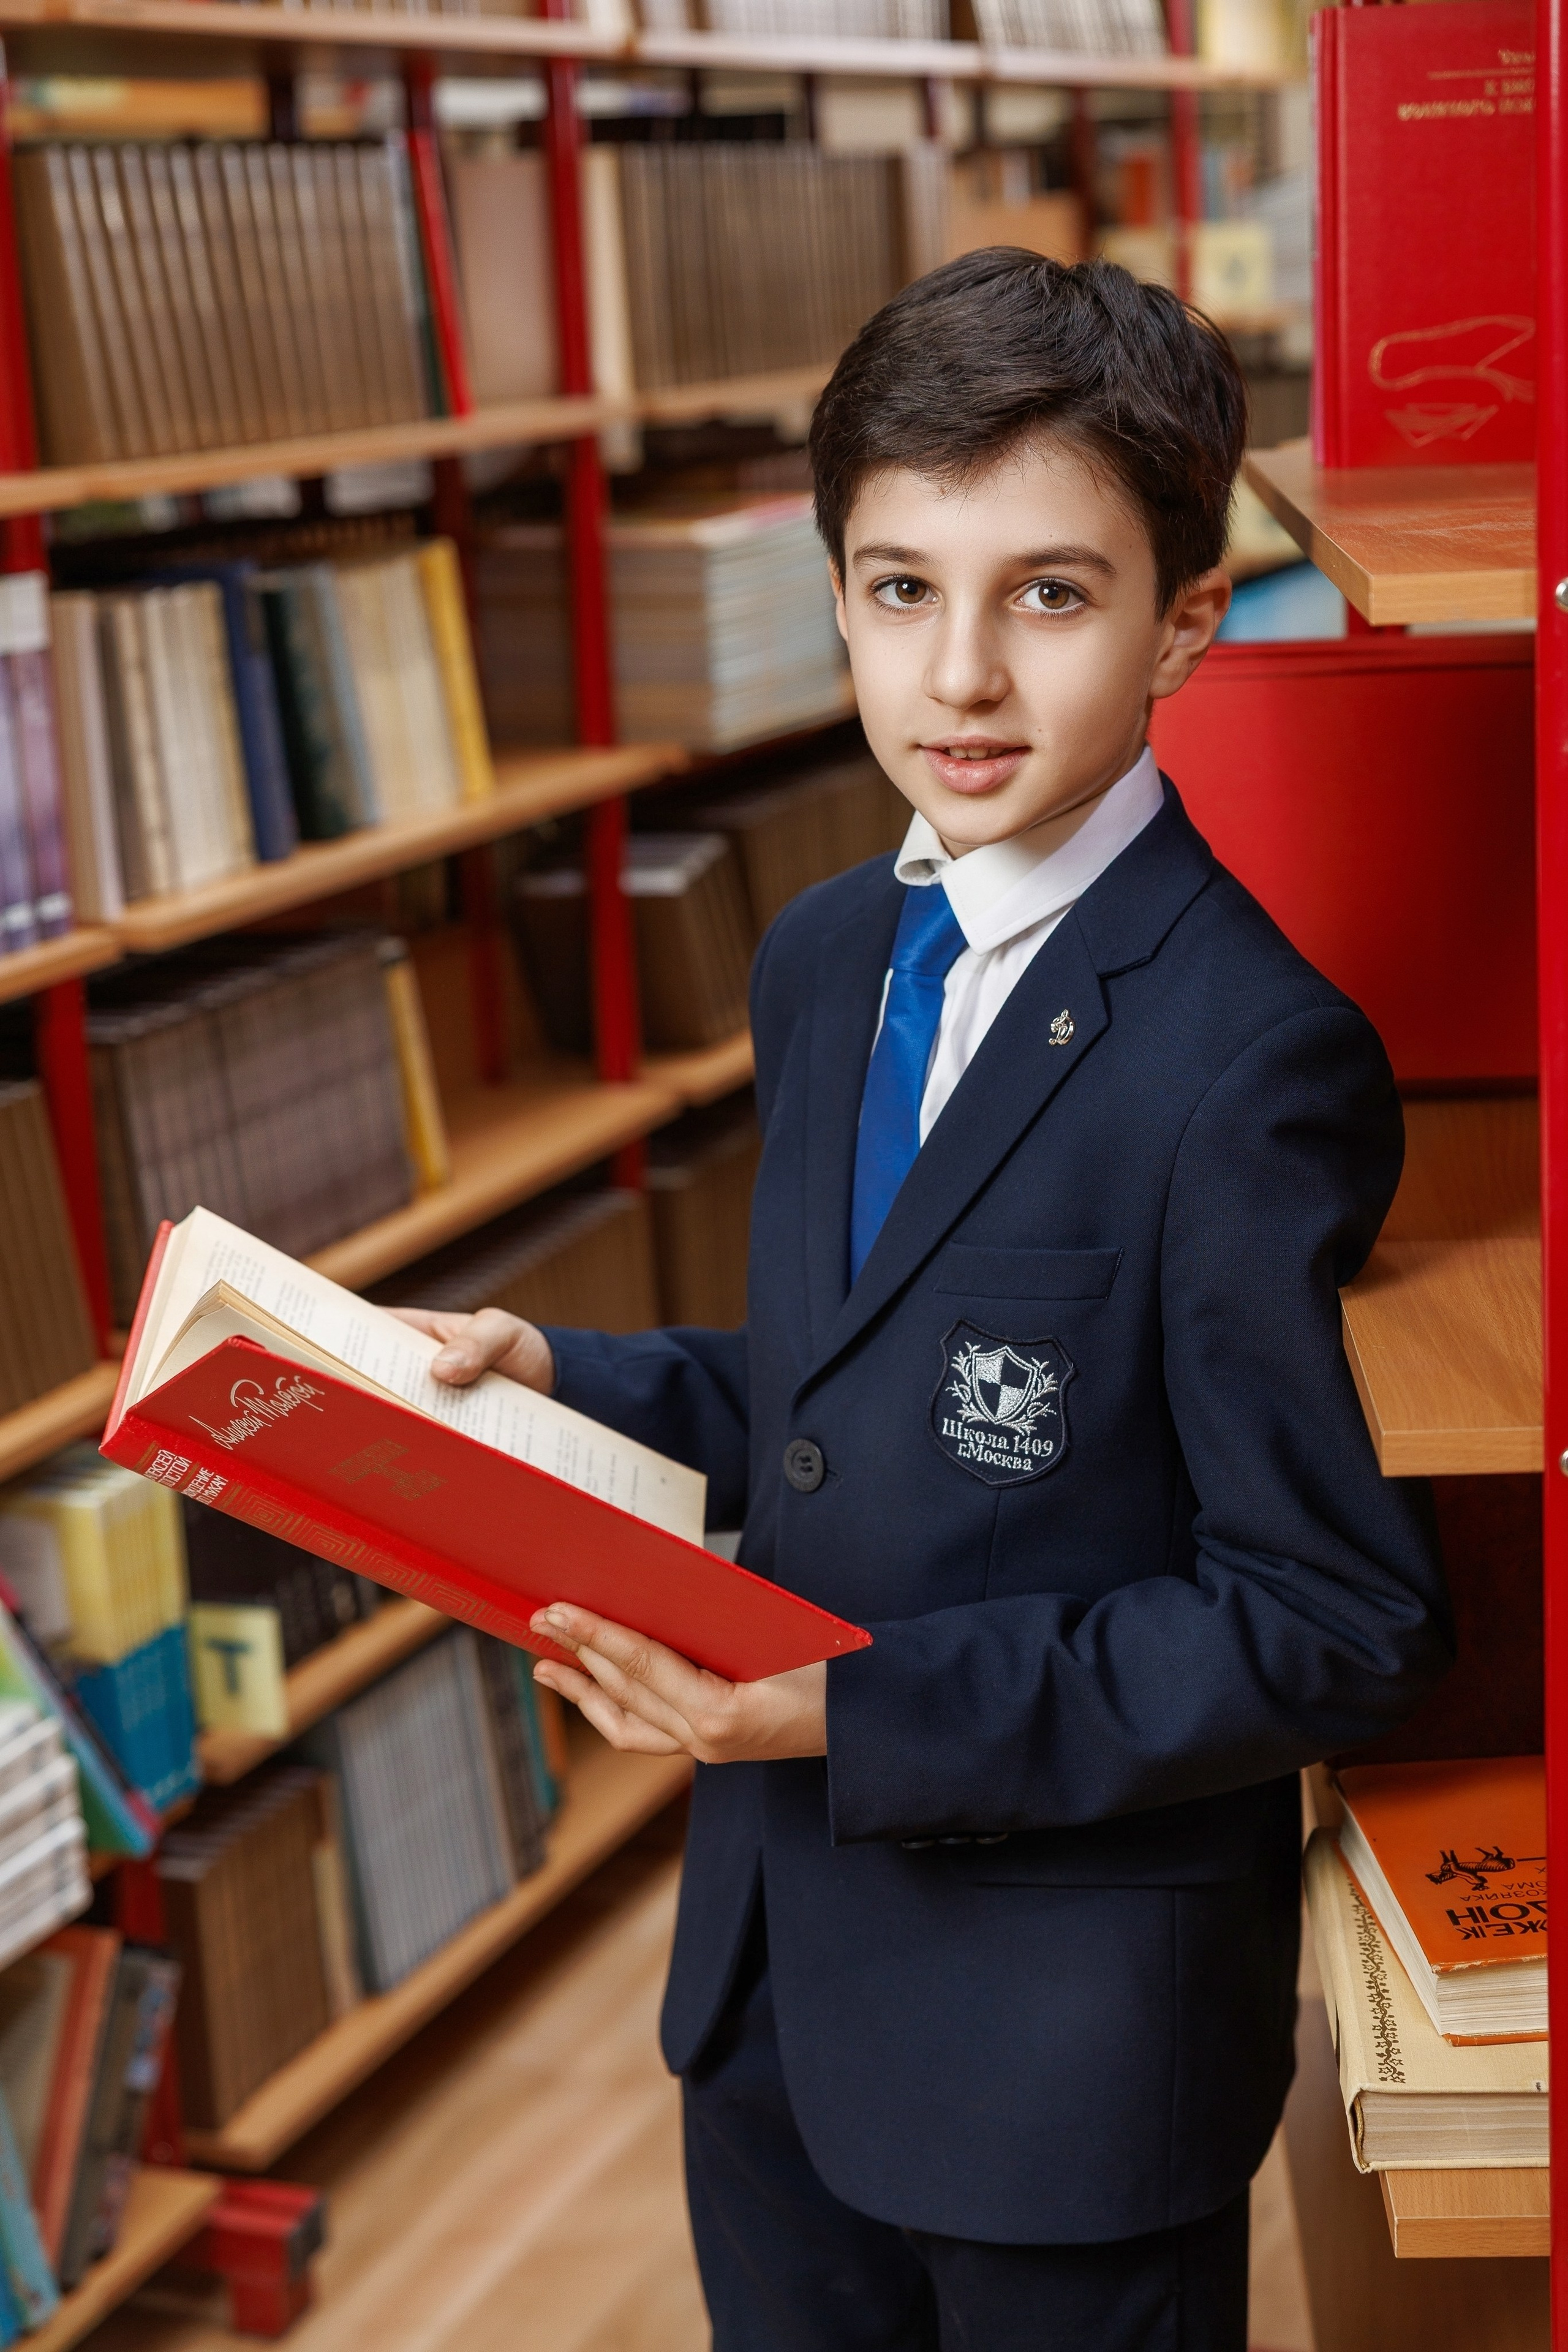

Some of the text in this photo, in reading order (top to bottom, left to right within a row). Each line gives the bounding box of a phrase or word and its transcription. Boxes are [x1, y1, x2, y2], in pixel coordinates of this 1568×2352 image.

[942, 1417, 1054, 1457] Школа 1409
[957, 1441, 1034, 1471] г.Москва
[204, 1475, 228, 1500] МУКАМ
